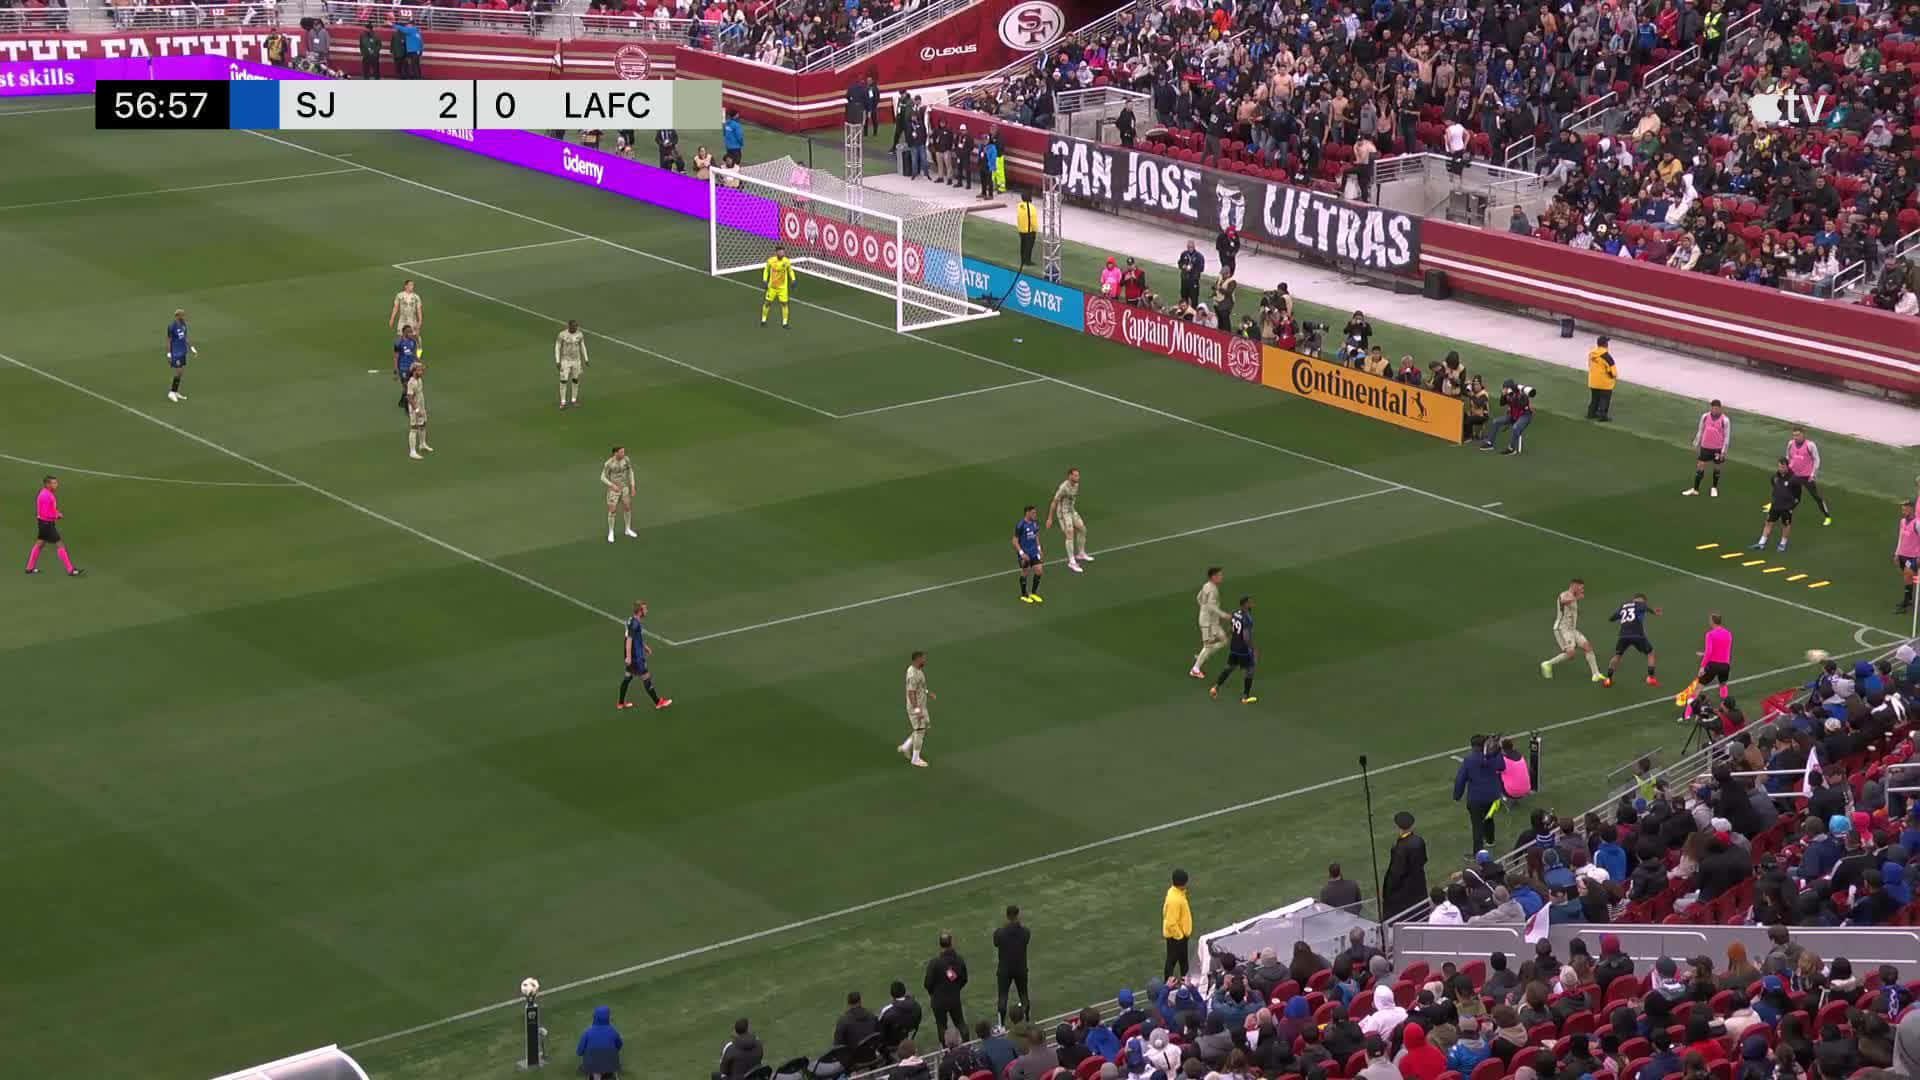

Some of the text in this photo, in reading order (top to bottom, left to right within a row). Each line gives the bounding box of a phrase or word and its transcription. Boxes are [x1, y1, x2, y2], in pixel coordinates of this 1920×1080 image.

[936, 44, 977, 57] LEXUS
[19, 68, 75, 87] skills
[1123, 152, 1201, 218] JOSE
[1263, 184, 1412, 268] ULTRAS
[961, 268, 990, 291] AT&T
[1034, 289, 1063, 313] AT&T
[1122, 309, 1168, 347] Captain
[1168, 319, 1223, 369] Morgan
[1291, 358, 1407, 417] Continental
[1619, 607, 1636, 625] 23
